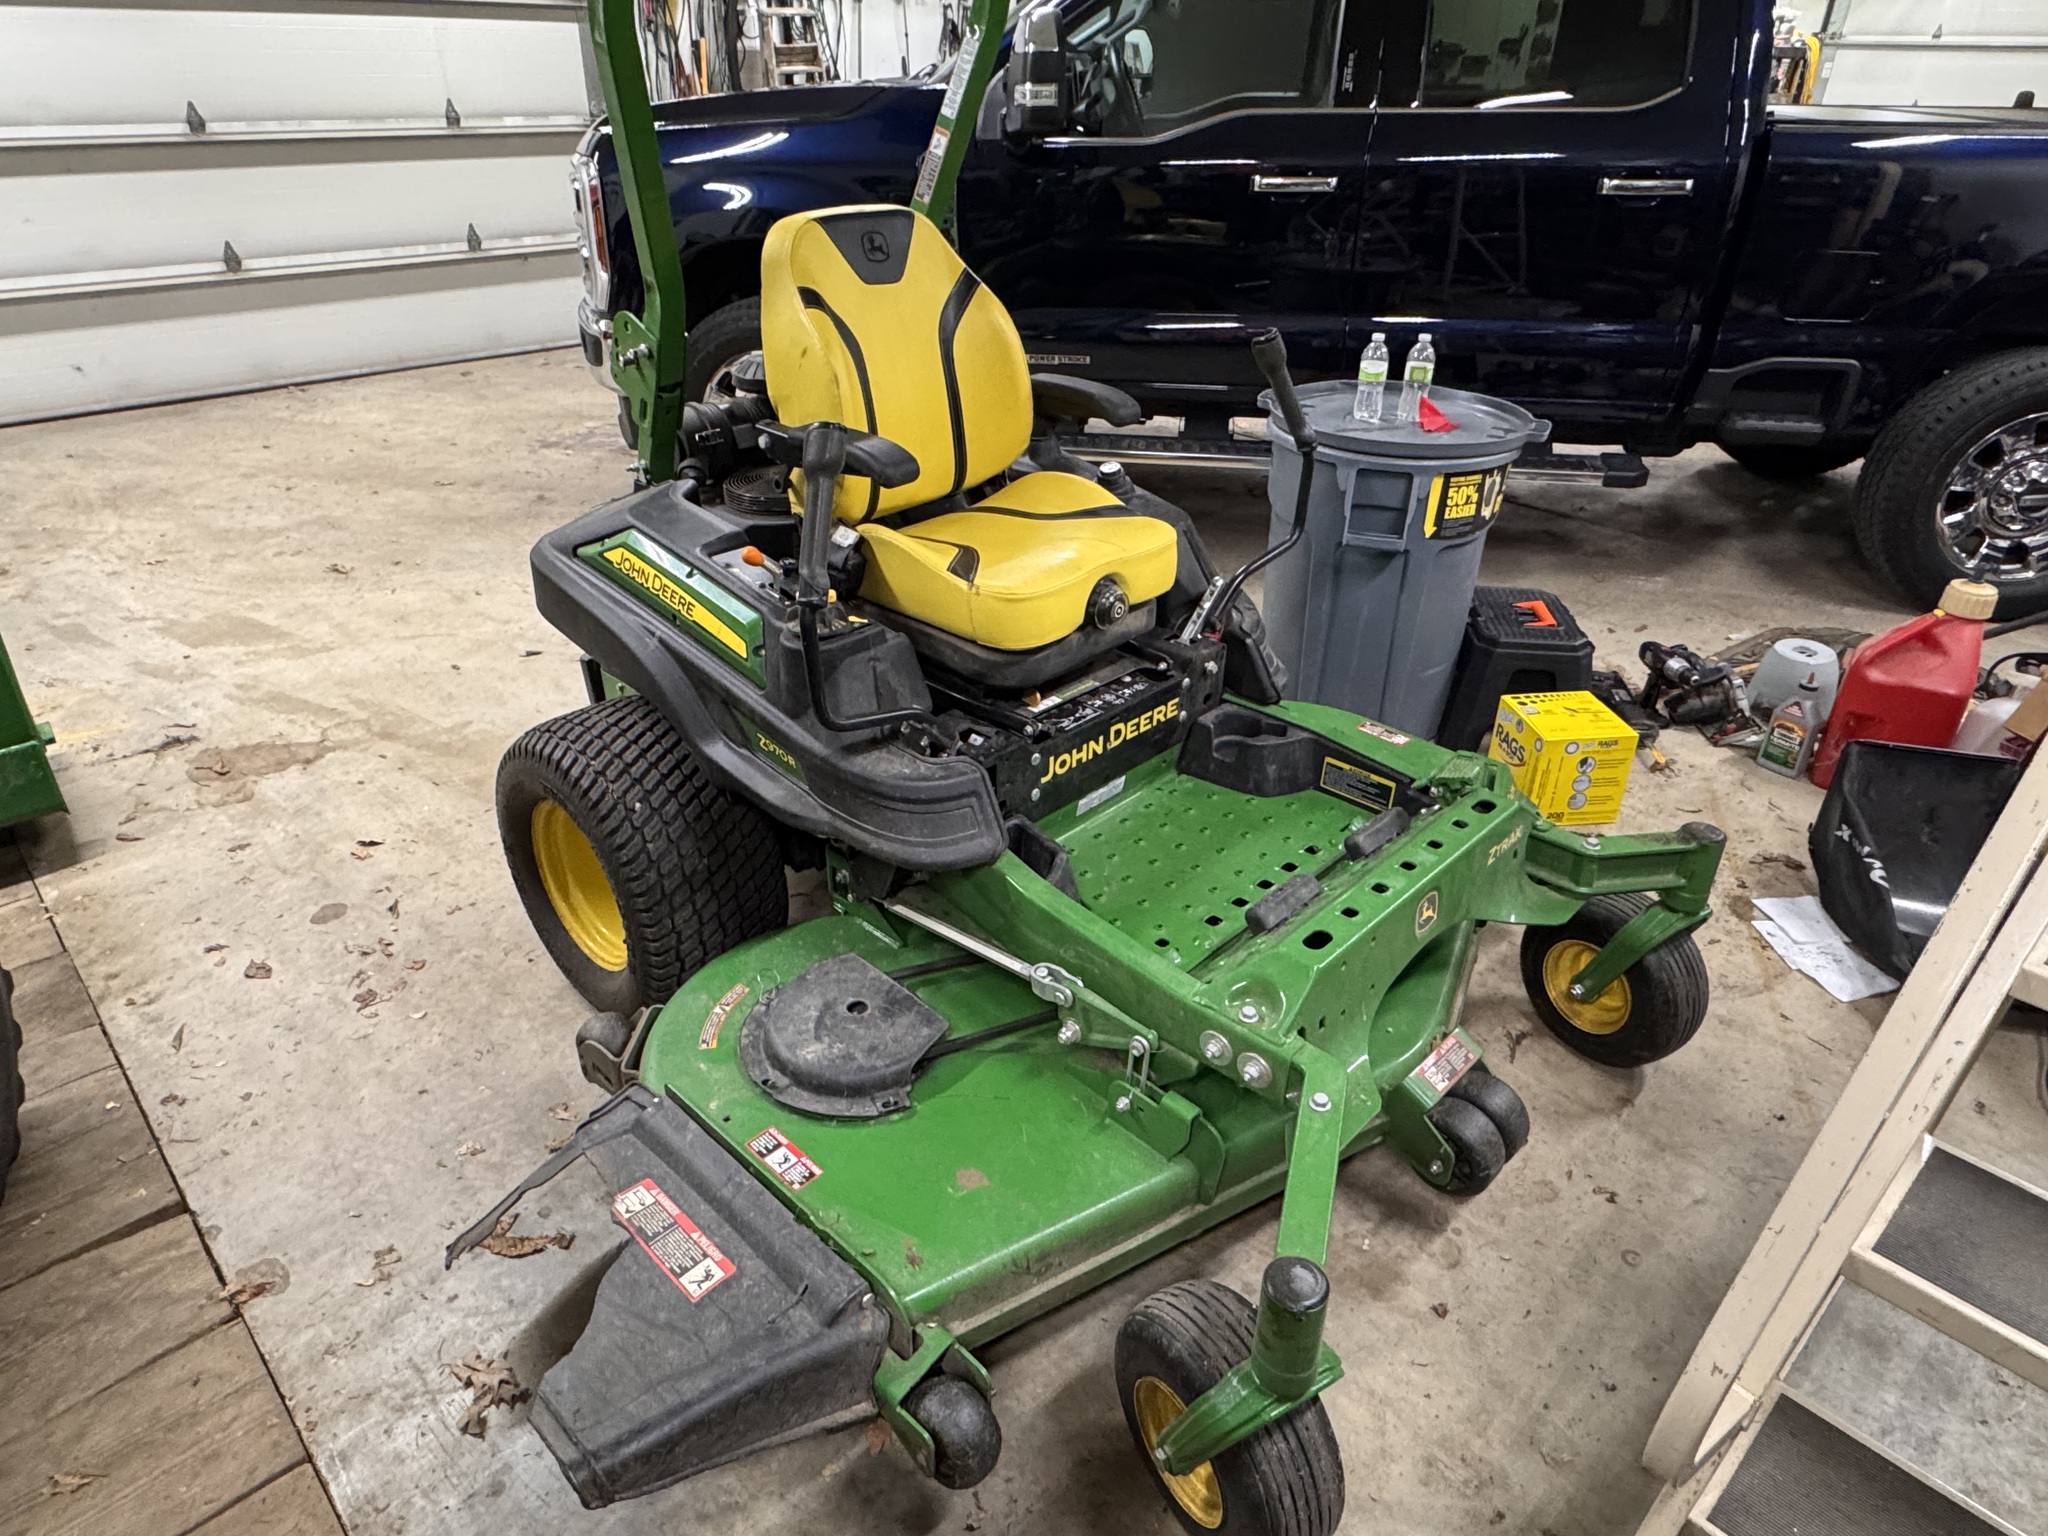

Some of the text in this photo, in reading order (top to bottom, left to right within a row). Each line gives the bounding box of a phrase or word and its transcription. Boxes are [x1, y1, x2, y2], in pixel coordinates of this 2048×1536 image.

[1444, 504, 1477, 519] EASIER
[1447, 485, 1479, 506] 50%
[615, 551, 697, 618] JOHN DEERE
[756, 732, 797, 769] Z970R
[1040, 697, 1180, 784] JOHN DEERE
[1495, 722, 1526, 763] RAGS
[1597, 739, 1619, 747] RAGS
[1546, 811, 1564, 820] 200
[1486, 824, 1523, 867] ZTRAK
[697, 1234, 724, 1262] PELIGRO
